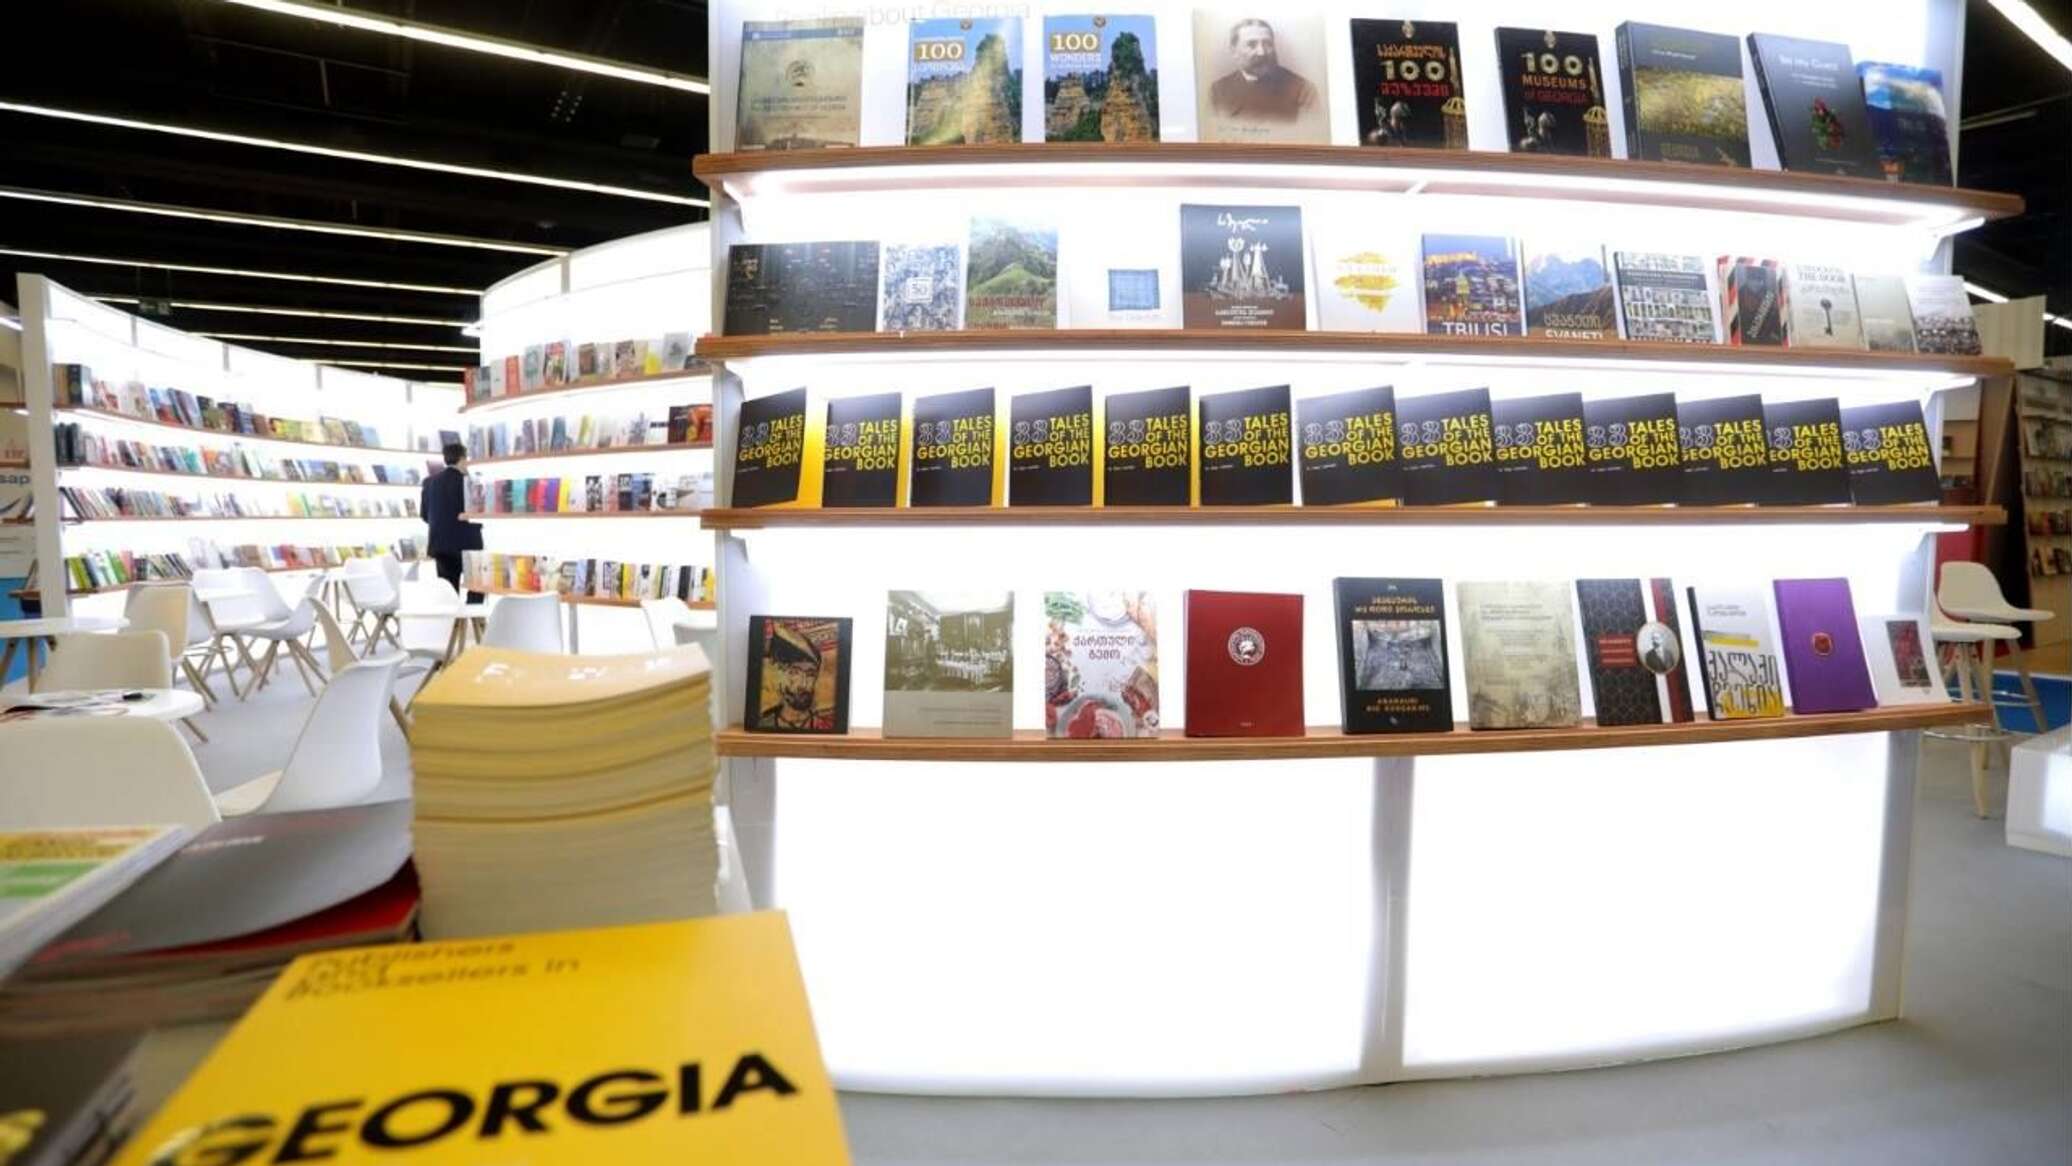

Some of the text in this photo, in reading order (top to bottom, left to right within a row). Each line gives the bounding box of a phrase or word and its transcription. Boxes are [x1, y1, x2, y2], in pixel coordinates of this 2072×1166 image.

[1055, 33, 1098, 51] 100
[918, 43, 962, 60] 100
[1380, 60, 1445, 81] 100
[1522, 52, 1583, 76] 100
[1522, 75, 1586, 89] MUSEUMS
[1442, 322, 1507, 337] TBILISI
[770, 415, 802, 432] TALES
[859, 419, 897, 434] TALES
[952, 415, 991, 432] TALES
[1050, 413, 1089, 430] TALES
[1145, 414, 1188, 430] TALES
[1244, 413, 1288, 430] TALES
[1346, 412, 1392, 429] TALES
[1441, 414, 1488, 430] TALES
[1535, 419, 1581, 434] TALES
[1628, 418, 1675, 434] TALES
[1713, 419, 1761, 435] TALES
[770, 428, 801, 443] OF THE
[953, 429, 991, 443] OF THE
[1050, 428, 1090, 441] OF THE
[1145, 428, 1188, 442] OF THE
[1244, 427, 1288, 441] OF THE
[1346, 427, 1392, 441] OF THE
[1443, 428, 1489, 442] OF THE
[1630, 431, 1676, 445] OF THE
[1792, 423, 1838, 438] TALES
[1880, 423, 1923, 437] TALES
[859, 432, 896, 446] OF THE
[1537, 432, 1581, 446] OF THE
[1716, 432, 1763, 446] OF THE
[1795, 434, 1839, 448] OF THE
[1883, 435, 1927, 448] OF THE
[739, 440, 800, 462] GEORGIAN
[823, 444, 896, 460] GEORGIAN
[918, 440, 991, 459] GEORGIAN
[1014, 439, 1090, 459] GEORGIAN
[1108, 440, 1188, 458] GEORGIAN
[1204, 438, 1289, 458] GEORGIAN
[1306, 437, 1394, 458] GEORGIAN
[1403, 438, 1492, 458] GEORGIAN
[1497, 442, 1584, 460] GEORGIAN
[1590, 442, 1678, 460] GEORGIAN
[1770, 446, 1841, 461] EORGIAN
[1848, 446, 1928, 463] GEORGIAN
[766, 454, 798, 469] BOOK
[856, 456, 895, 470] BOOK
[952, 453, 990, 469] BOOK
[1049, 453, 1089, 467] BOOK
[1145, 453, 1186, 469] BOOK
[1244, 452, 1288, 467] BOOK
[1348, 450, 1394, 466] BOOK
[1446, 450, 1493, 466] BOOK
[1539, 454, 1586, 469] BOOK
[1633, 454, 1679, 469] BOOK
[1720, 453, 1767, 469] BOOK
[1798, 457, 1842, 471] BOOK
[1888, 456, 1930, 470] BOOK
[148, 1052, 800, 1166] GEORGIA
